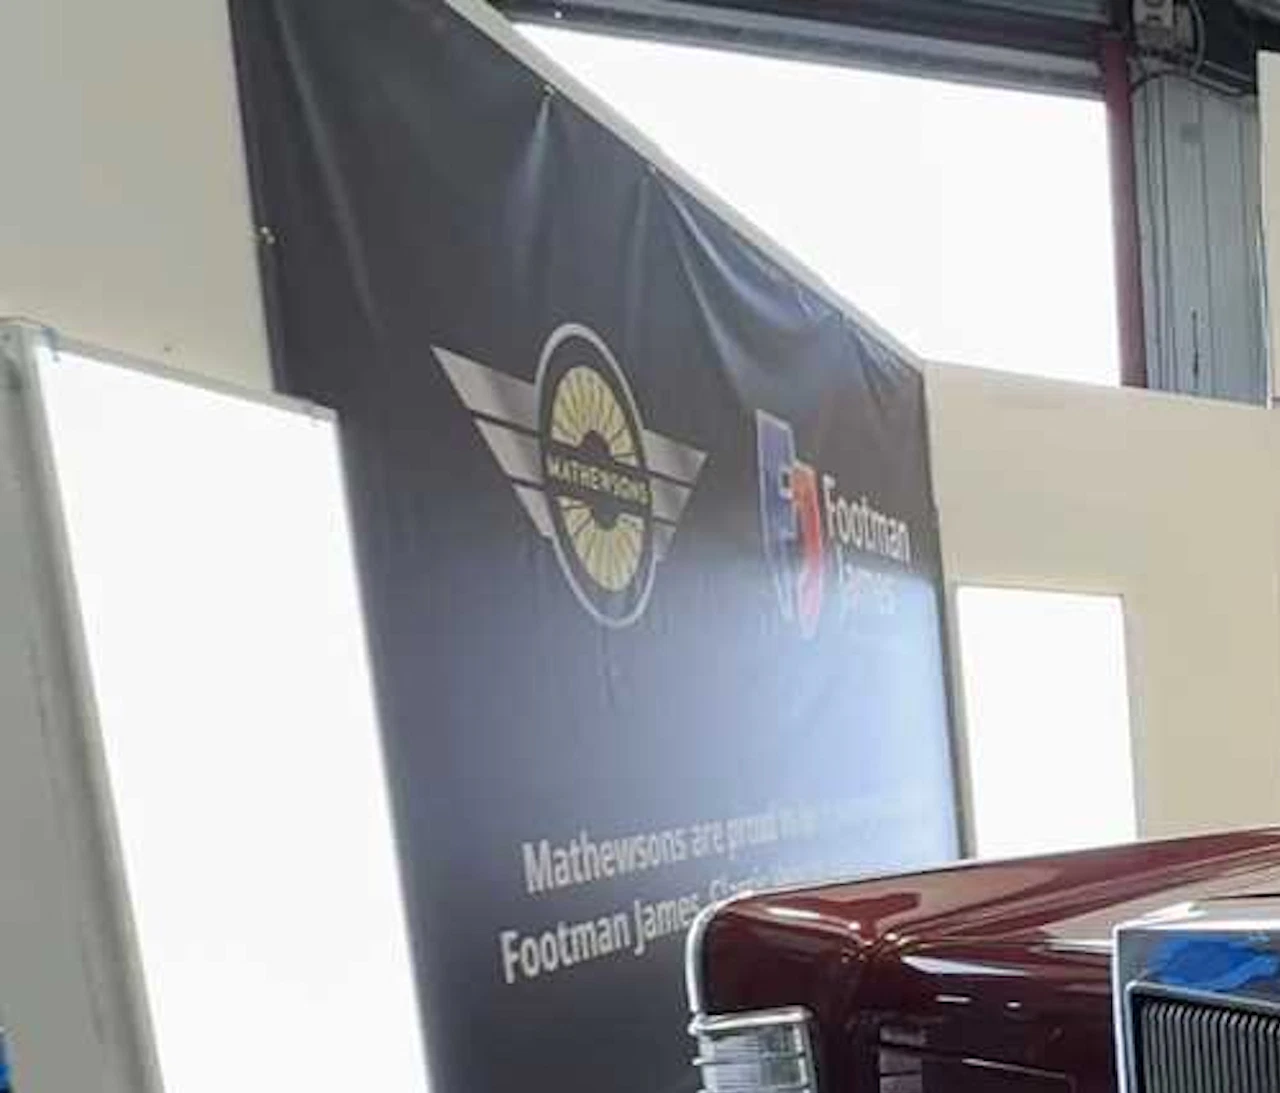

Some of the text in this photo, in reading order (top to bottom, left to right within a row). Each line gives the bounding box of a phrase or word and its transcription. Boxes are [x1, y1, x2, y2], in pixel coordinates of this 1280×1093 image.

[822, 472, 911, 563] Footman
[521, 828, 686, 893] Mathewsons
[690, 818, 726, 859] are
[501, 908, 632, 984] Footman
